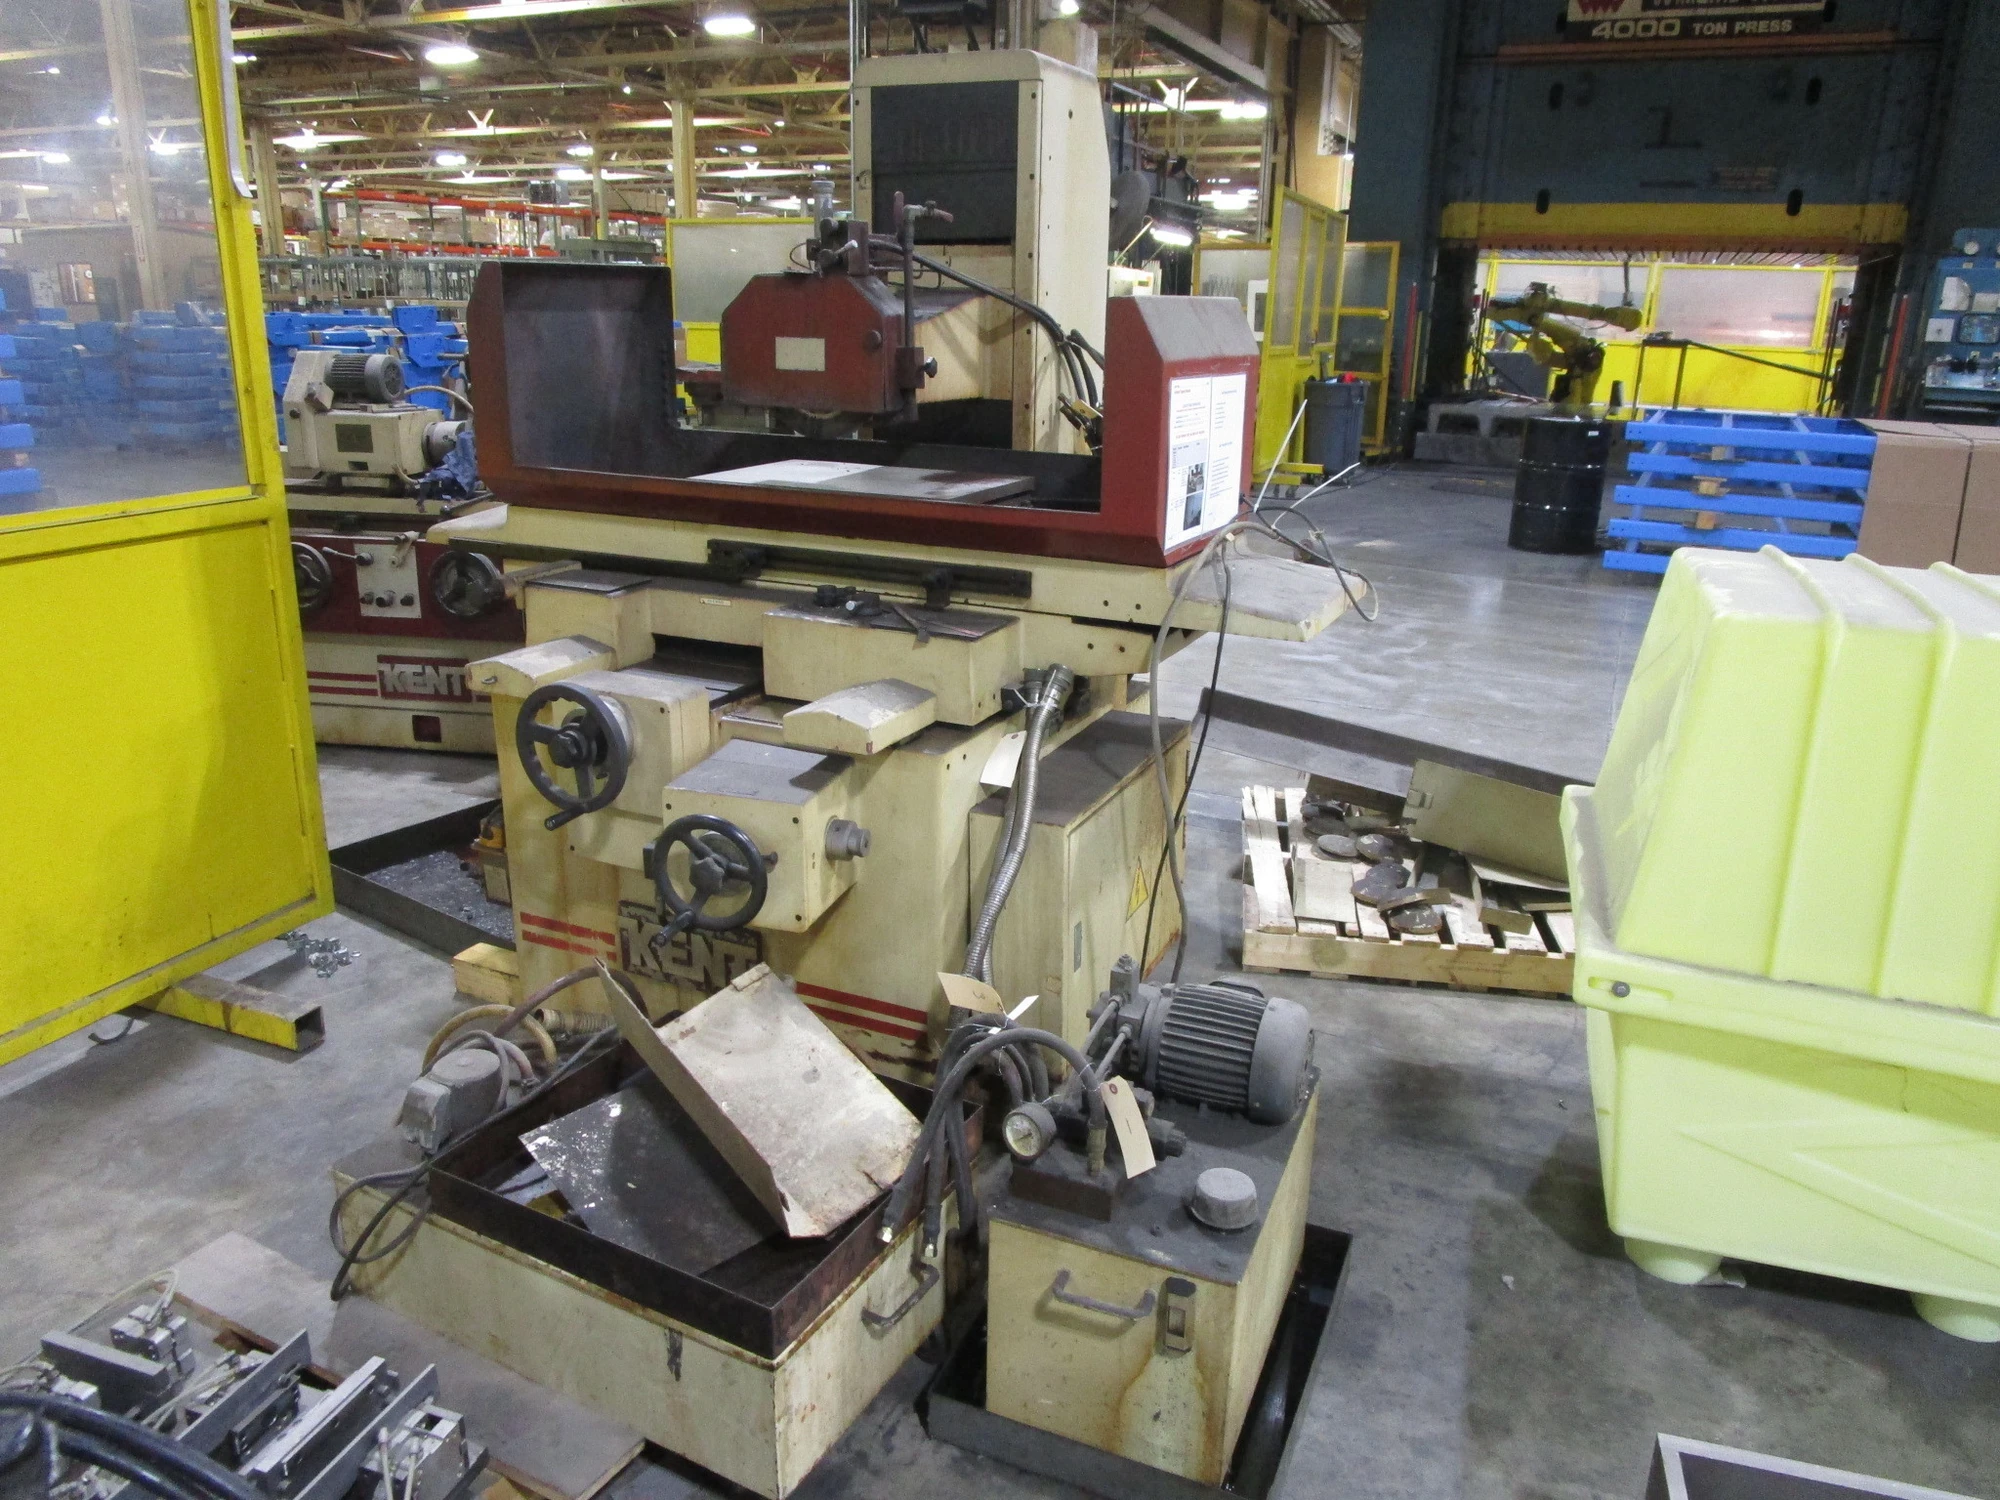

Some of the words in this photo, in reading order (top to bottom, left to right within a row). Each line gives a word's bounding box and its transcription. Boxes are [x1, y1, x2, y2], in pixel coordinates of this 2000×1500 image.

[1591, 18, 1682, 40] 4000
[1692, 21, 1728, 36] TON
[1734, 19, 1793, 34] PRESS
[378, 662, 467, 697] KENT
[618, 913, 760, 988] KENT
